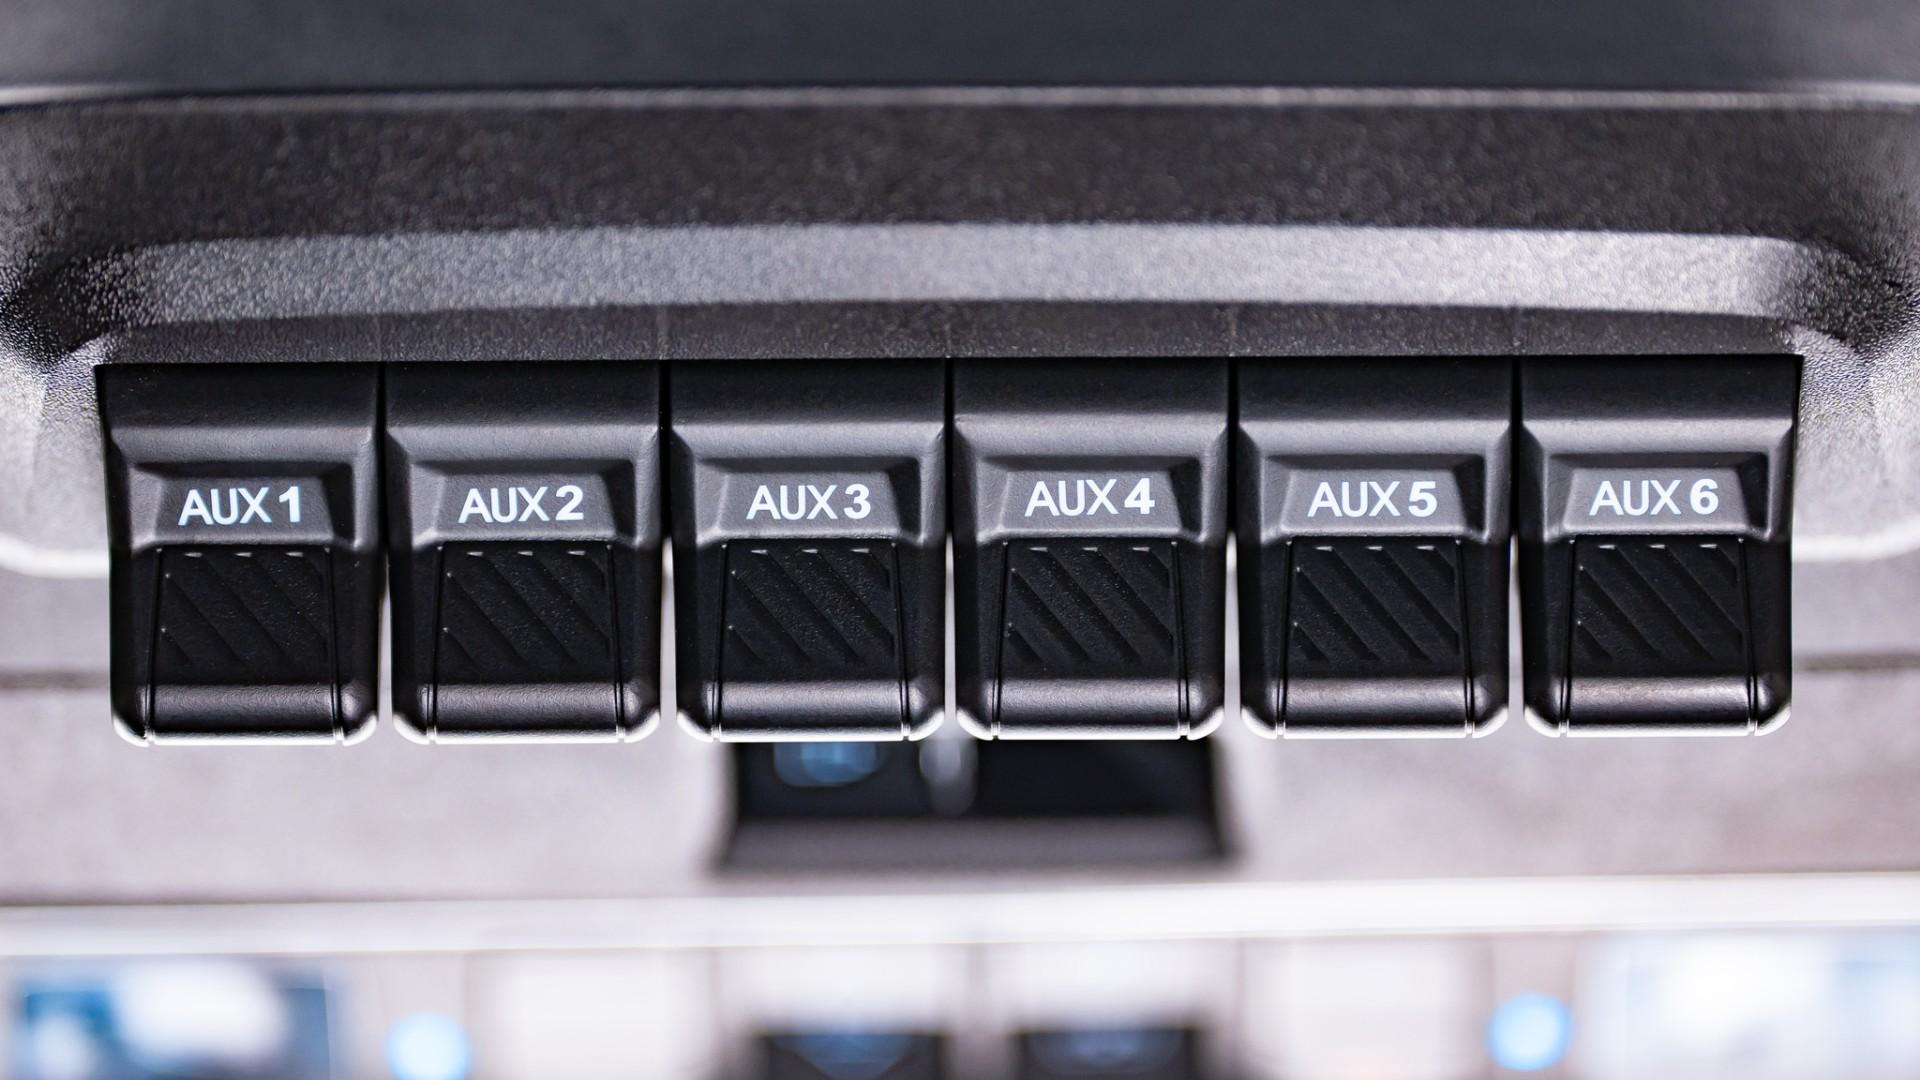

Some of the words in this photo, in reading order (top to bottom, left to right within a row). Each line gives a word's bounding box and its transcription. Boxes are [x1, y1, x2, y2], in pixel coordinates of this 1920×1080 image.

[179, 487, 272, 525] AUX
[279, 486, 301, 522] 1
[458, 486, 550, 523] AUX
[555, 484, 585, 521] 2
[746, 484, 838, 520] AUX
[843, 483, 872, 520] 3
[1025, 479, 1119, 517] AUX
[1122, 478, 1156, 515] 4
[1307, 480, 1401, 518] AUX
[1407, 480, 1438, 517] 5
[1589, 479, 1682, 516] AUX
[1689, 478, 1719, 515] 6
